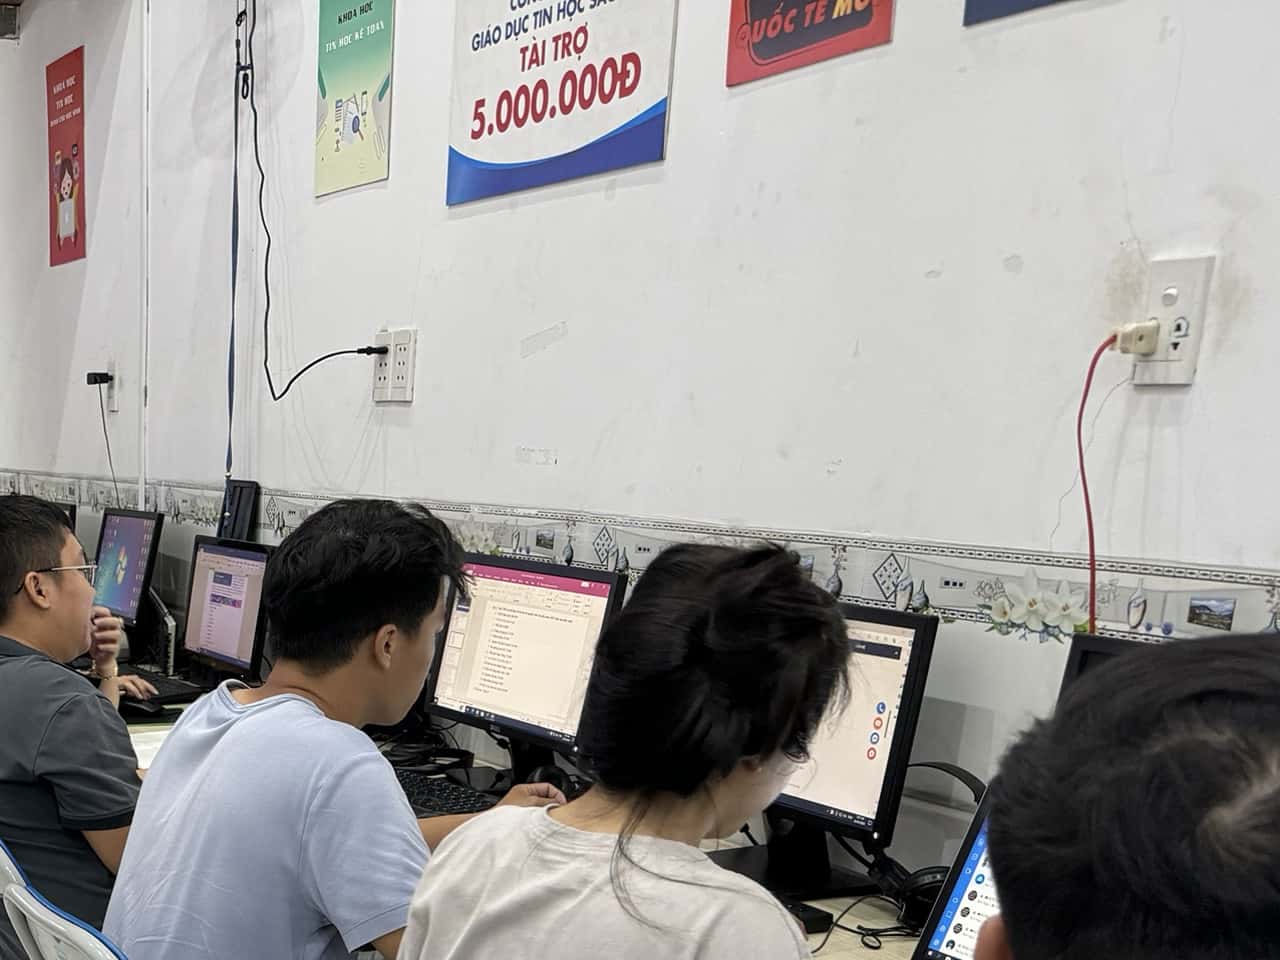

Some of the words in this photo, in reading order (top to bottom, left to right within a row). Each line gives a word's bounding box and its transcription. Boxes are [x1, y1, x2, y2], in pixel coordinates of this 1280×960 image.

[471, 24, 502, 51] GIÁO
[504, 14, 529, 41] DỤC
[532, 6, 553, 30] TIN
[556, 0, 585, 22] HỌC
[519, 36, 547, 72] TÀI
[551, 22, 589, 61] TRỢ
[470, 52, 642, 140] 5.000.000Đ
